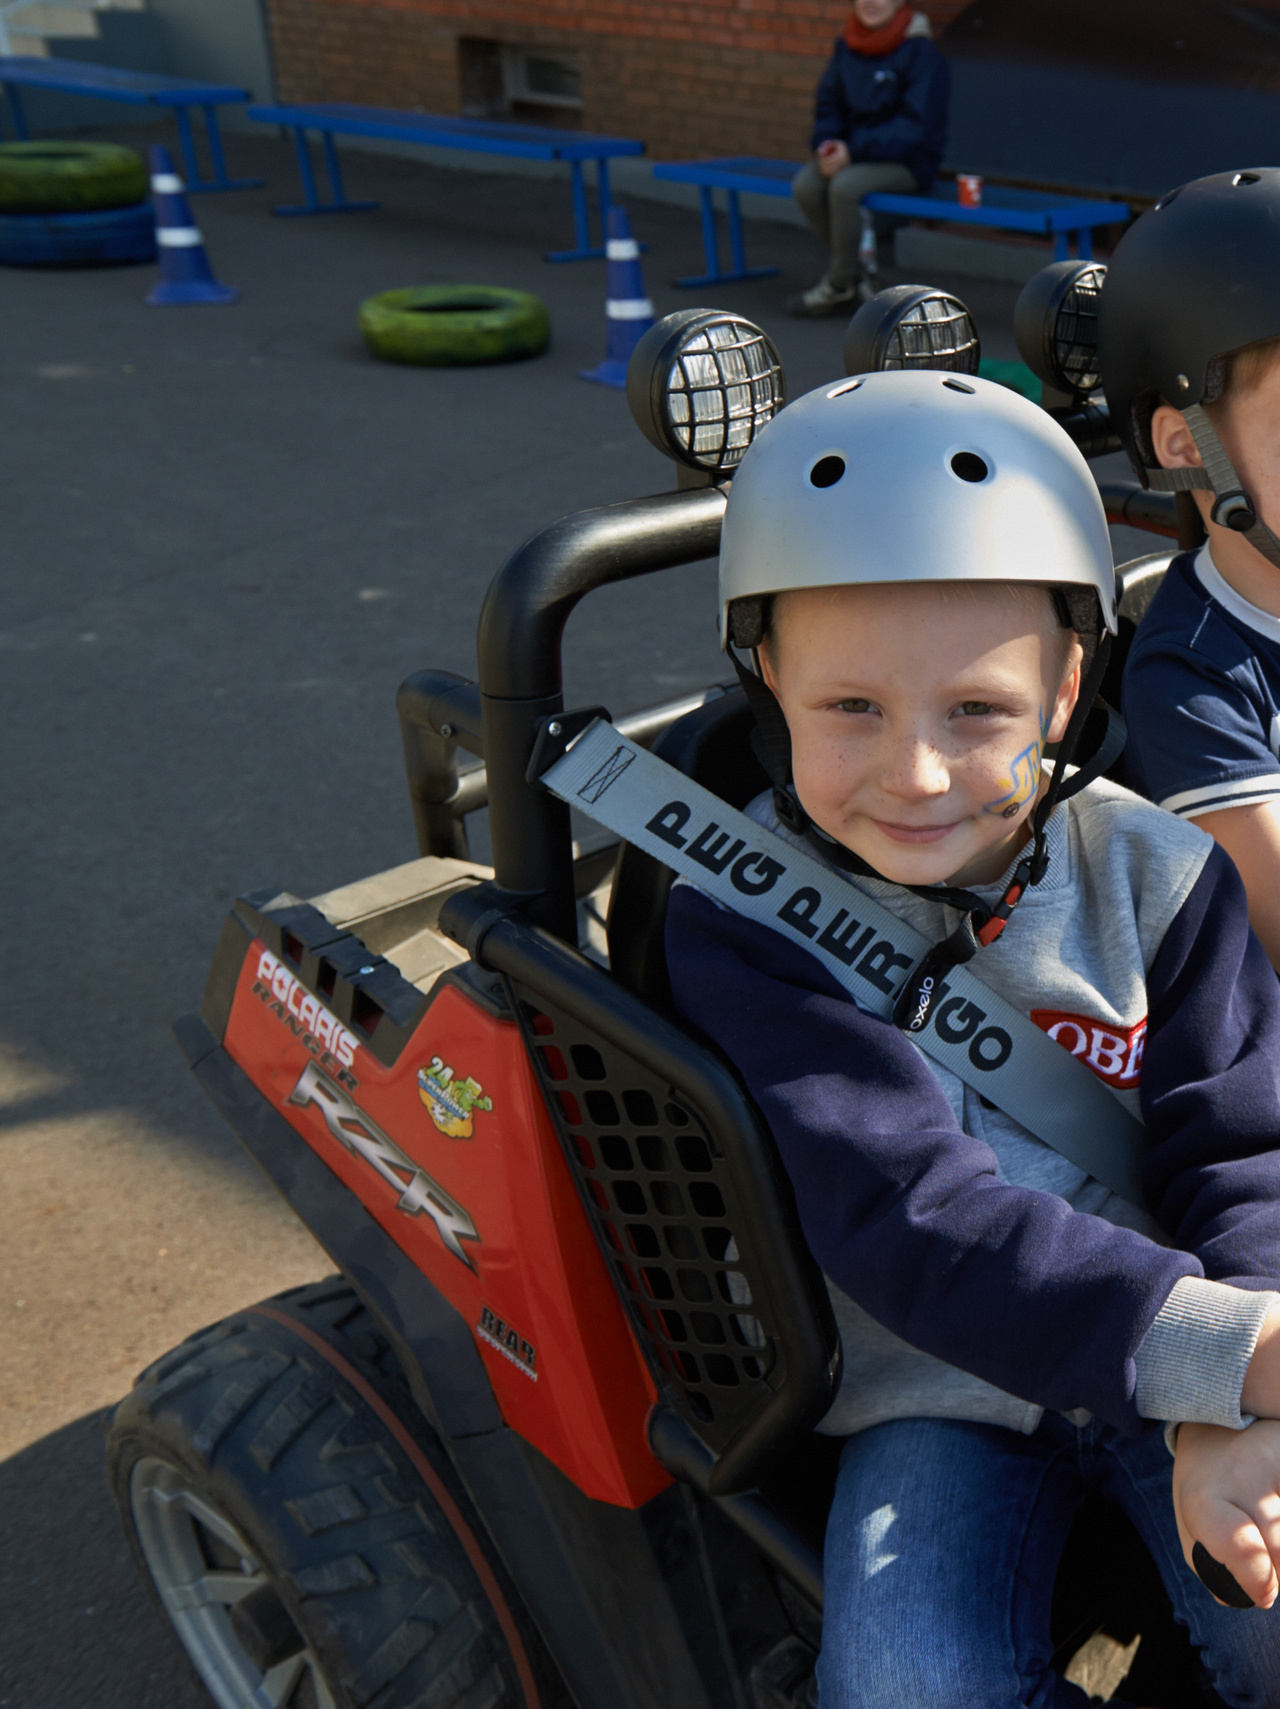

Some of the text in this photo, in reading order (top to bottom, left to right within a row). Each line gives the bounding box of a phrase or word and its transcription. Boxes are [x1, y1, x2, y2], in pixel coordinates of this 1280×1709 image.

[645, 800, 1013, 1072] PEG PERGO
[251, 980, 360, 1092] RANGER
[256, 950, 360, 1068] POLARIS
[909, 976, 935, 1030] oxelo
[425, 1056, 455, 1089] 24
[288, 1058, 483, 1280] RZR
[480, 1303, 537, 1368] REAR
